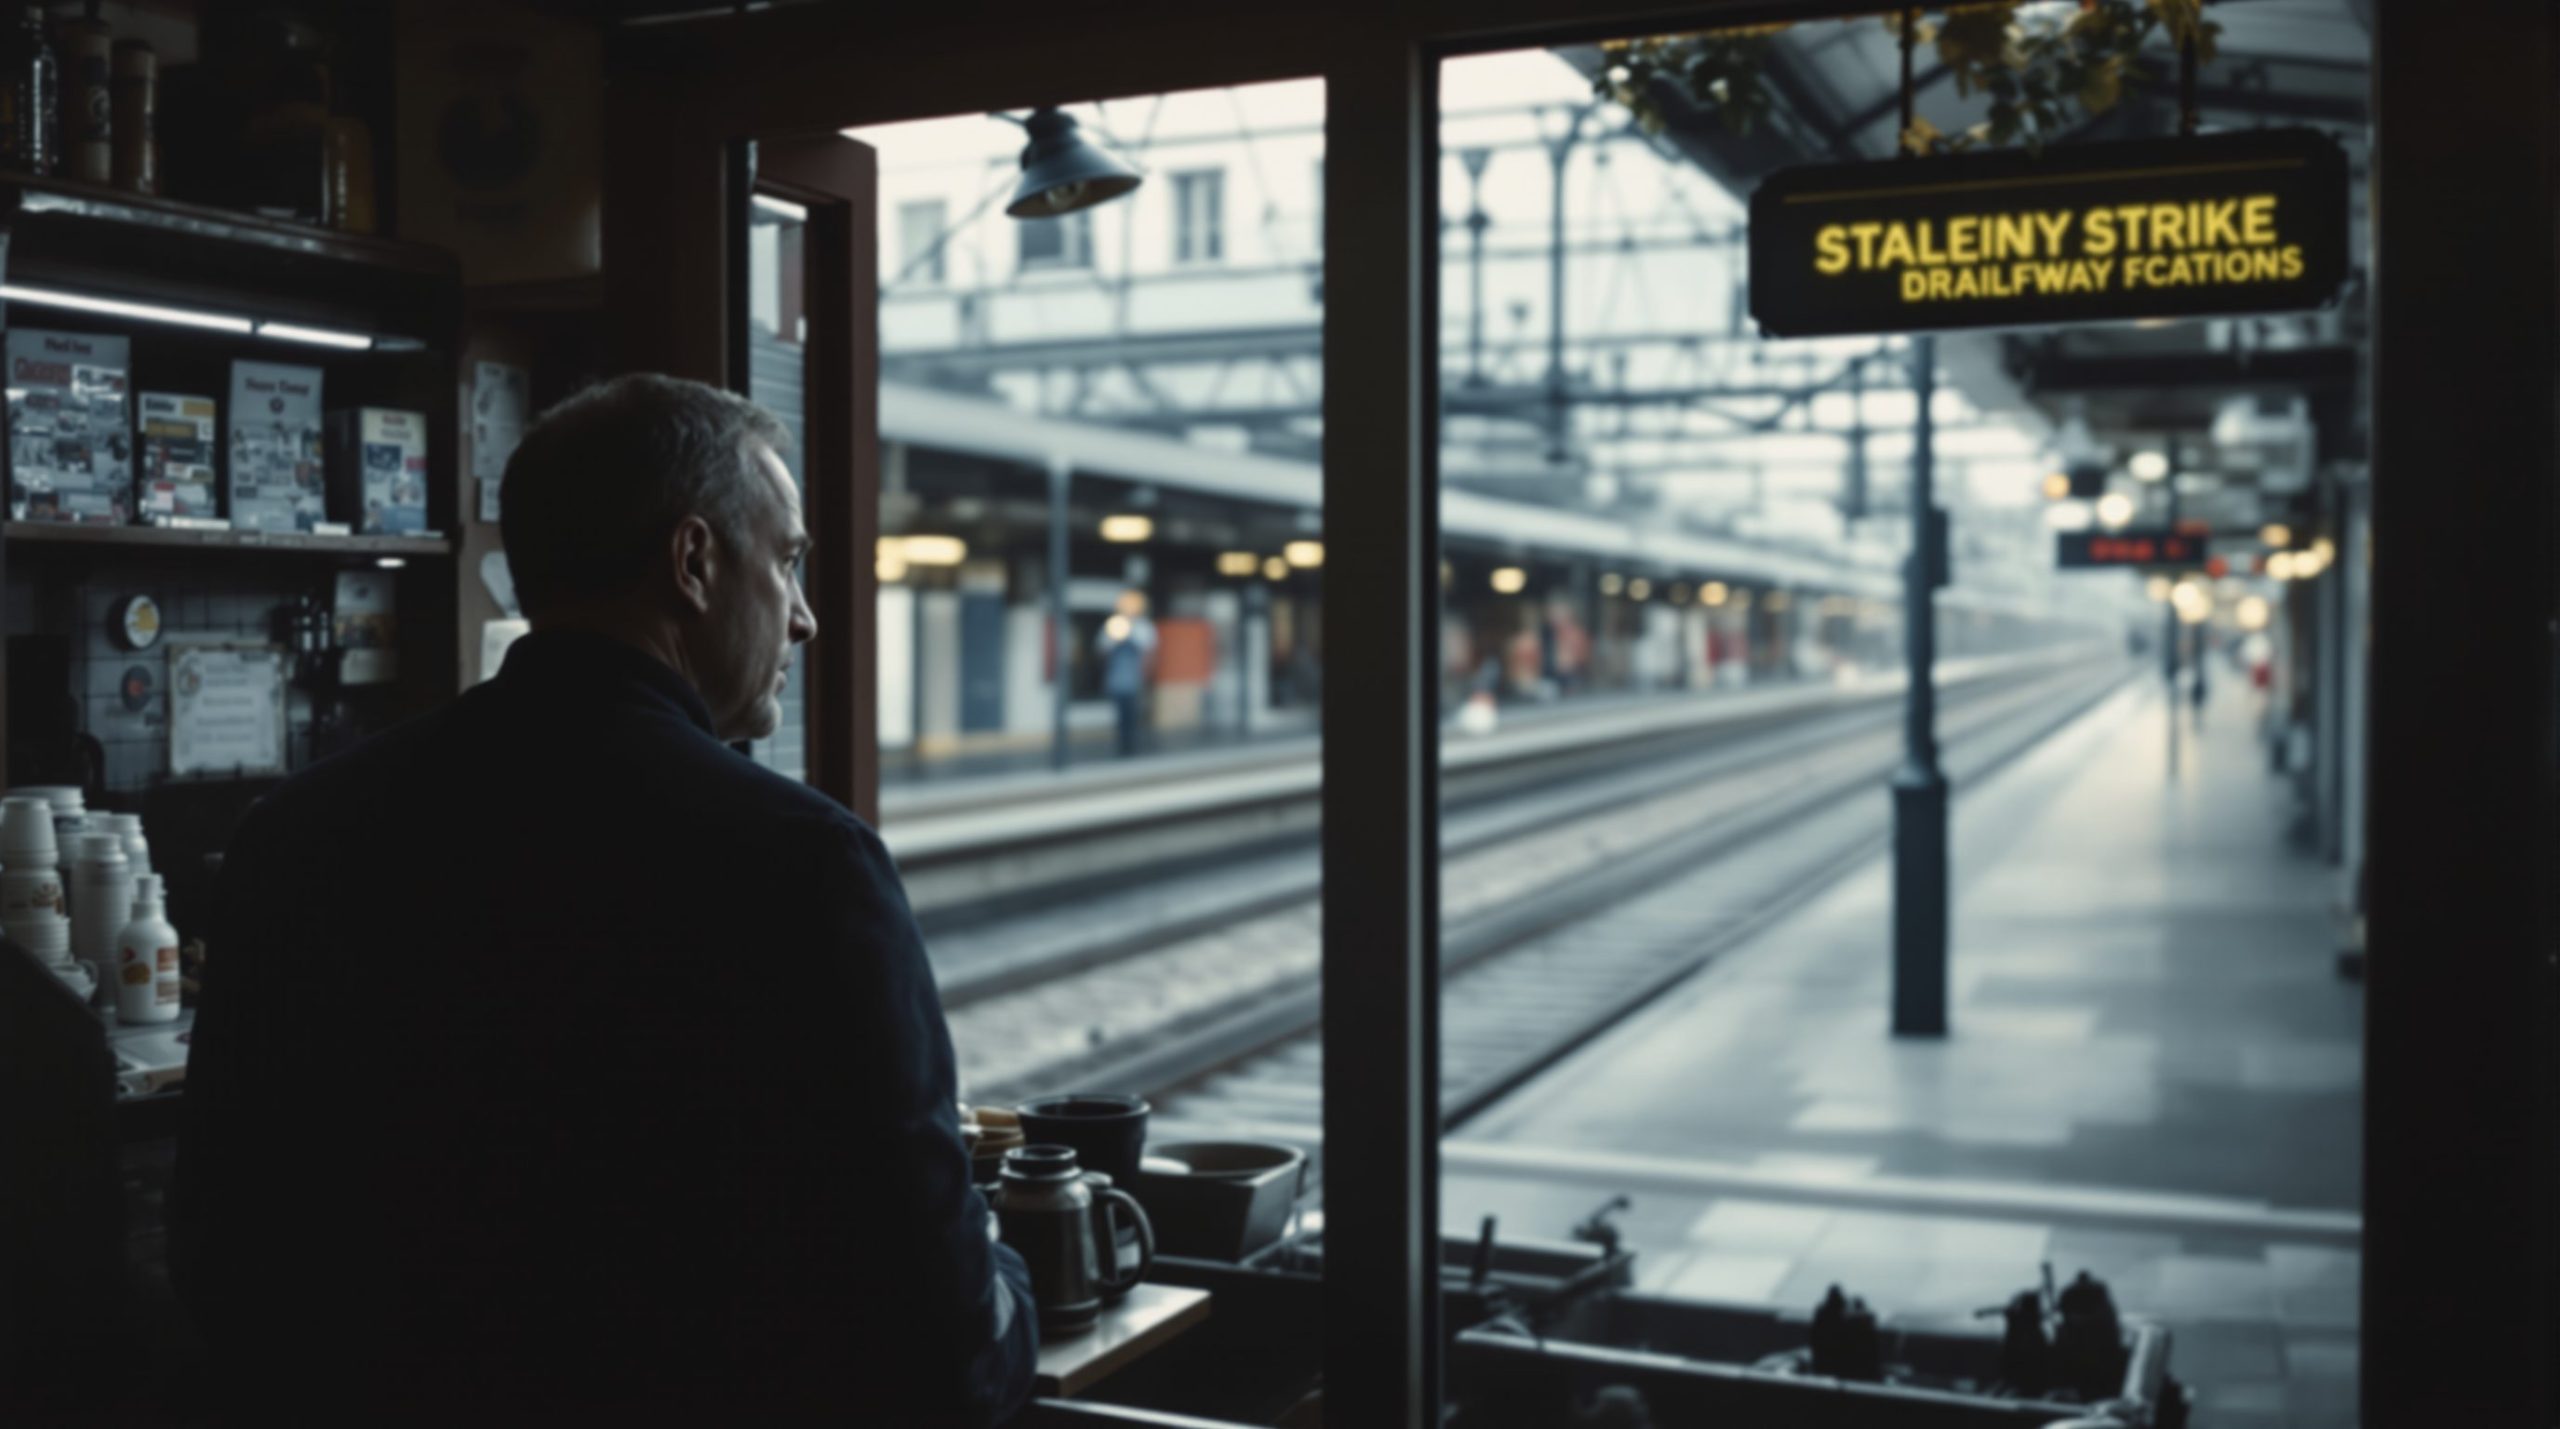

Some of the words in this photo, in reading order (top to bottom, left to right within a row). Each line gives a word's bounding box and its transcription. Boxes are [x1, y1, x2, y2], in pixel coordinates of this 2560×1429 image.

[1815, 210, 2072, 274] STALEINY
[2083, 195, 2277, 255] STRIKE
[1902, 260, 2113, 301] DRAILFWAY
[2123, 245, 2304, 288] FCATIONS
